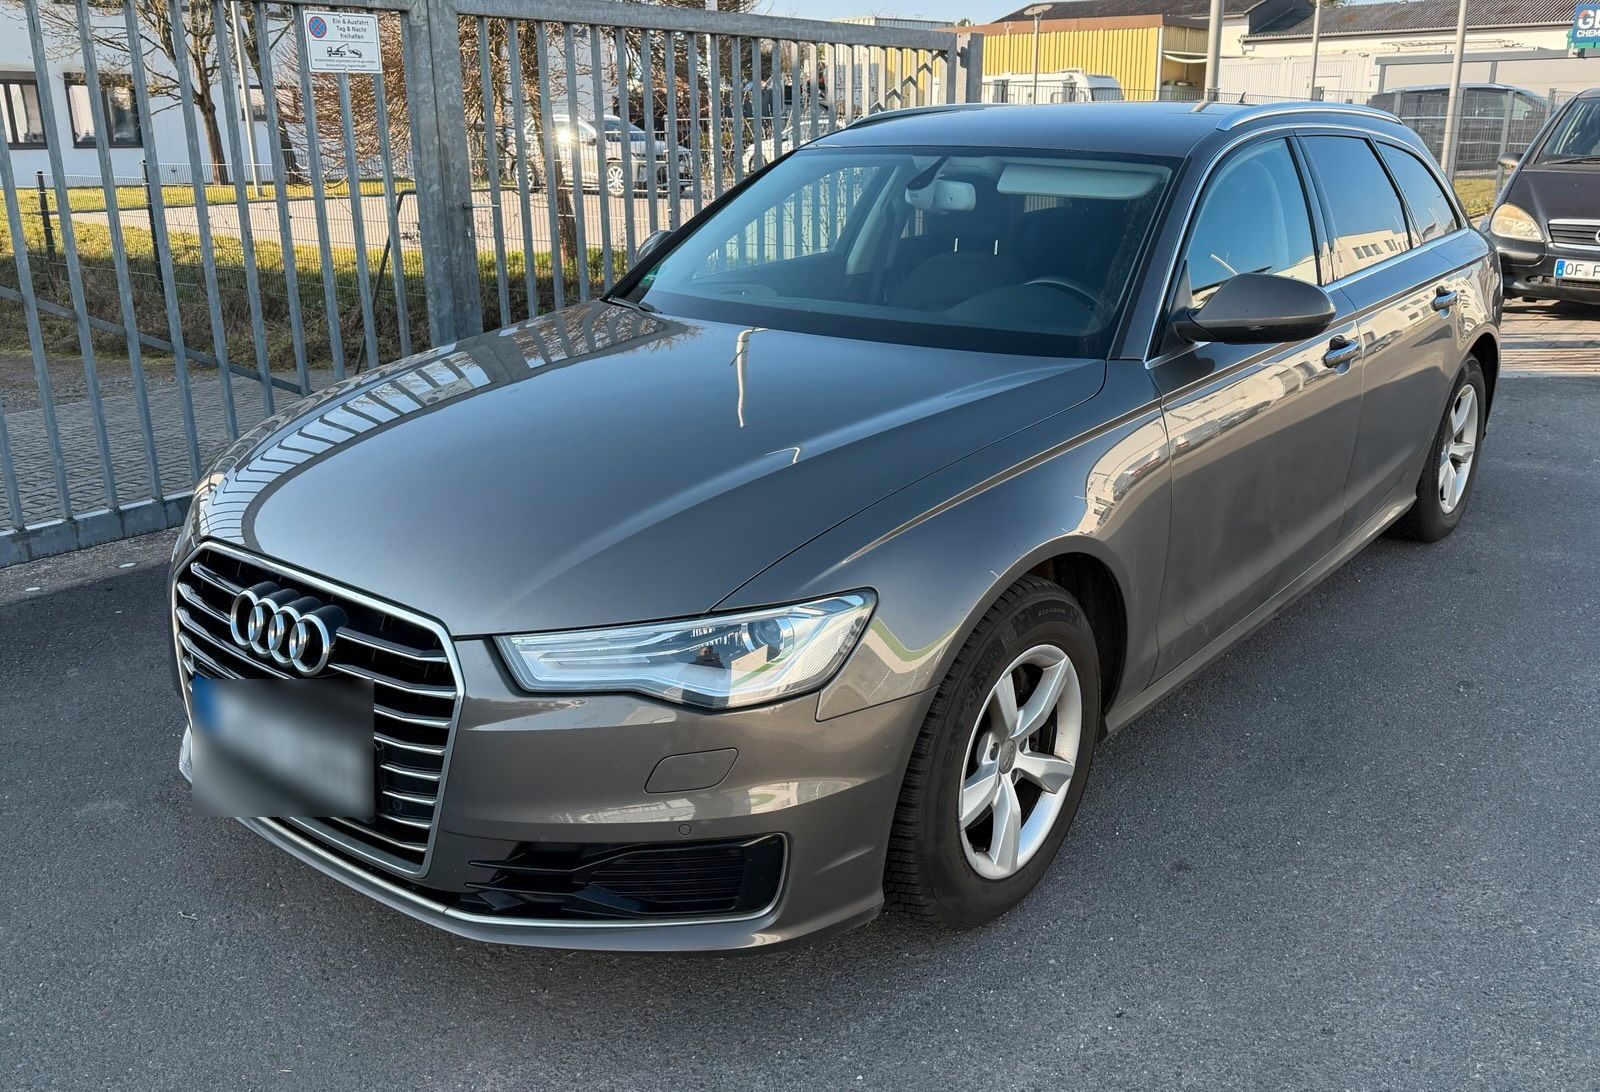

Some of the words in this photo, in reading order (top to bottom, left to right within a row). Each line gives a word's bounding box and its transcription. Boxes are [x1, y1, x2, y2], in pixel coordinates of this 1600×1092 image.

[347, 18, 369, 26] Ausfahrt
[336, 25, 345, 33] Tag
[1566, 263, 1584, 275] OF
